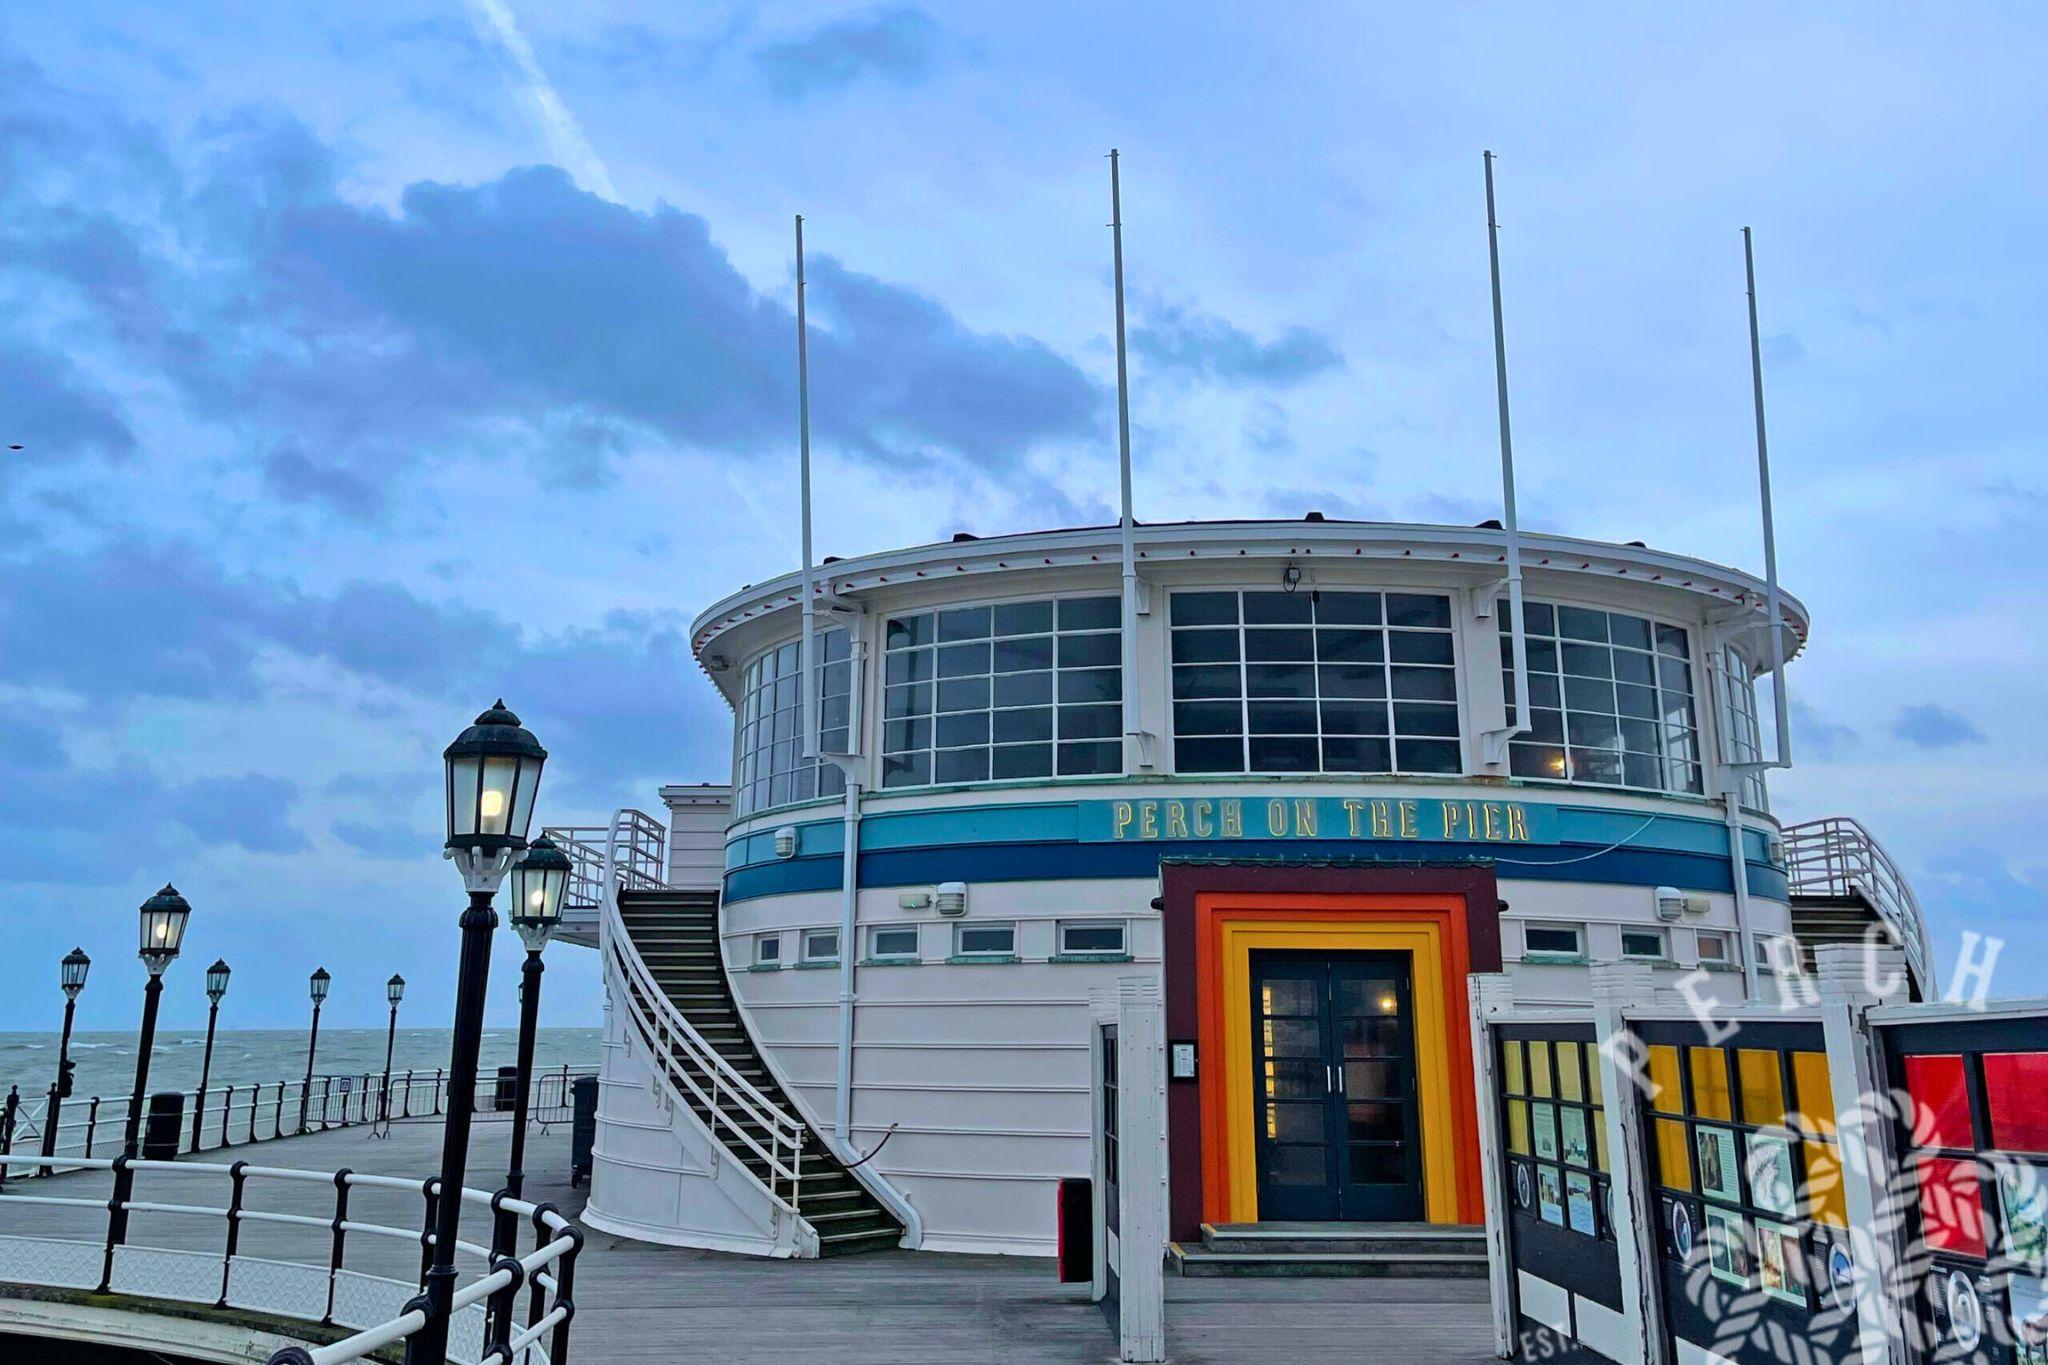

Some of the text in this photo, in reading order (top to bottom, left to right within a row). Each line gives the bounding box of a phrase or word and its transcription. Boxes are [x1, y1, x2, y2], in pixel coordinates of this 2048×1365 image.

[1113, 799, 1529, 841] PERCH ON THE PIER
